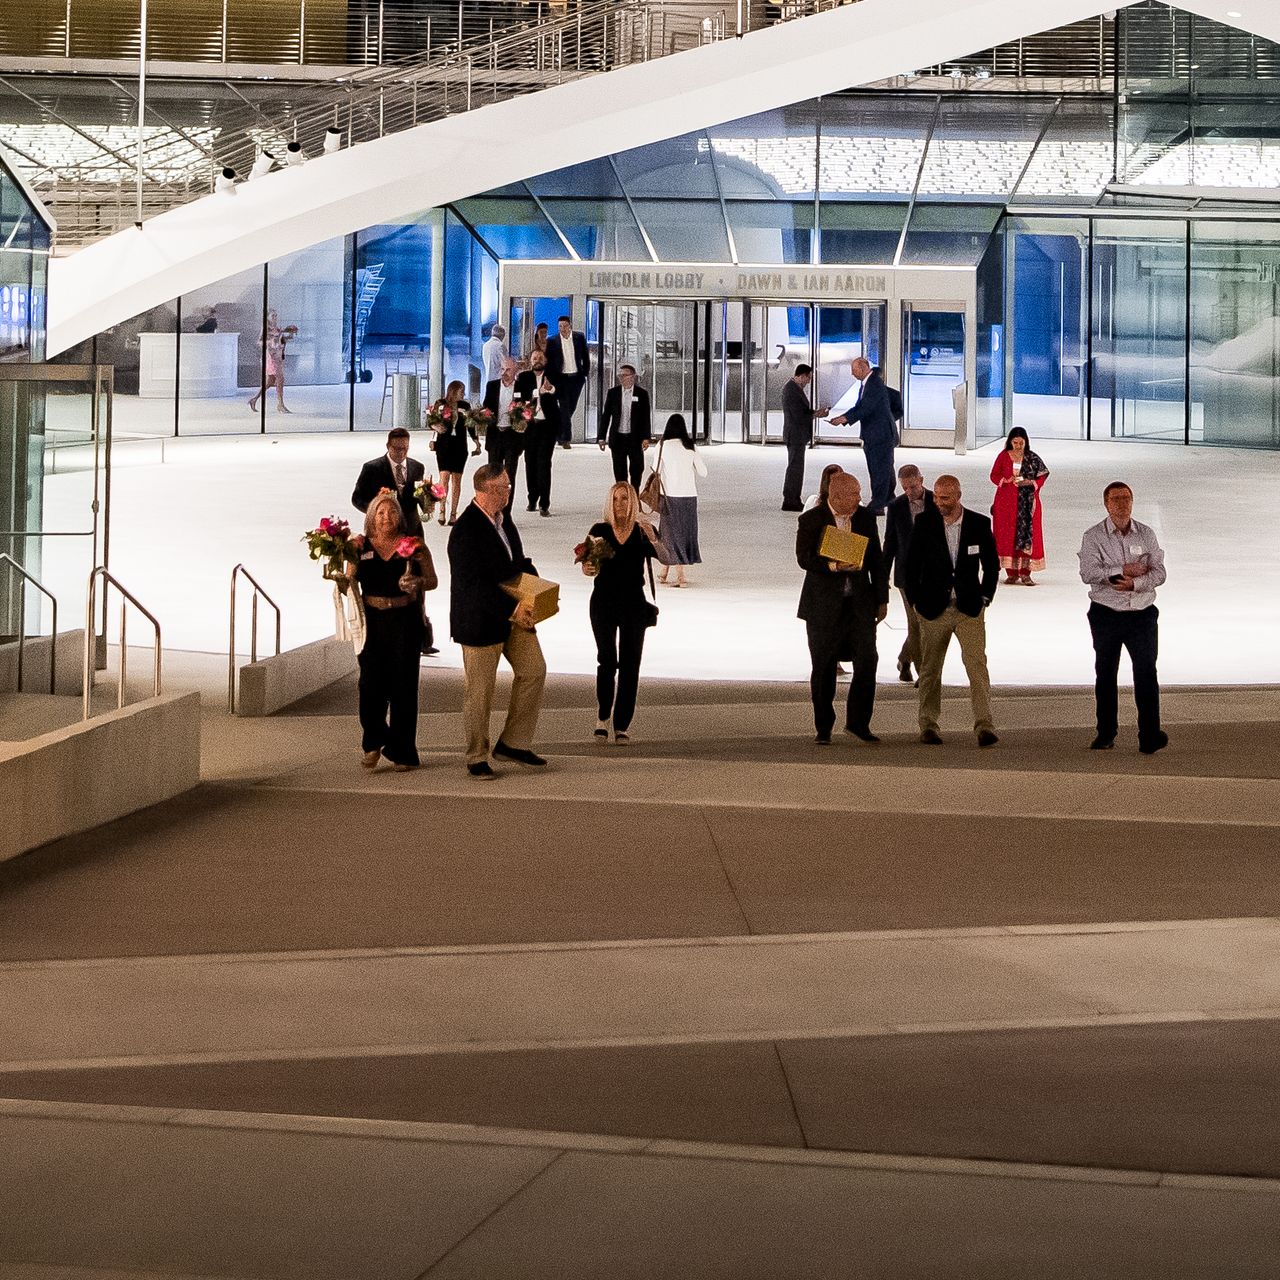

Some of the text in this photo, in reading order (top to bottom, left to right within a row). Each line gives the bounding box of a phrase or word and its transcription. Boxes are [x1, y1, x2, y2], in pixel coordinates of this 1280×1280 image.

[589, 271, 886, 291] LINCOLN LOBBY DAWN & IAN AARON
